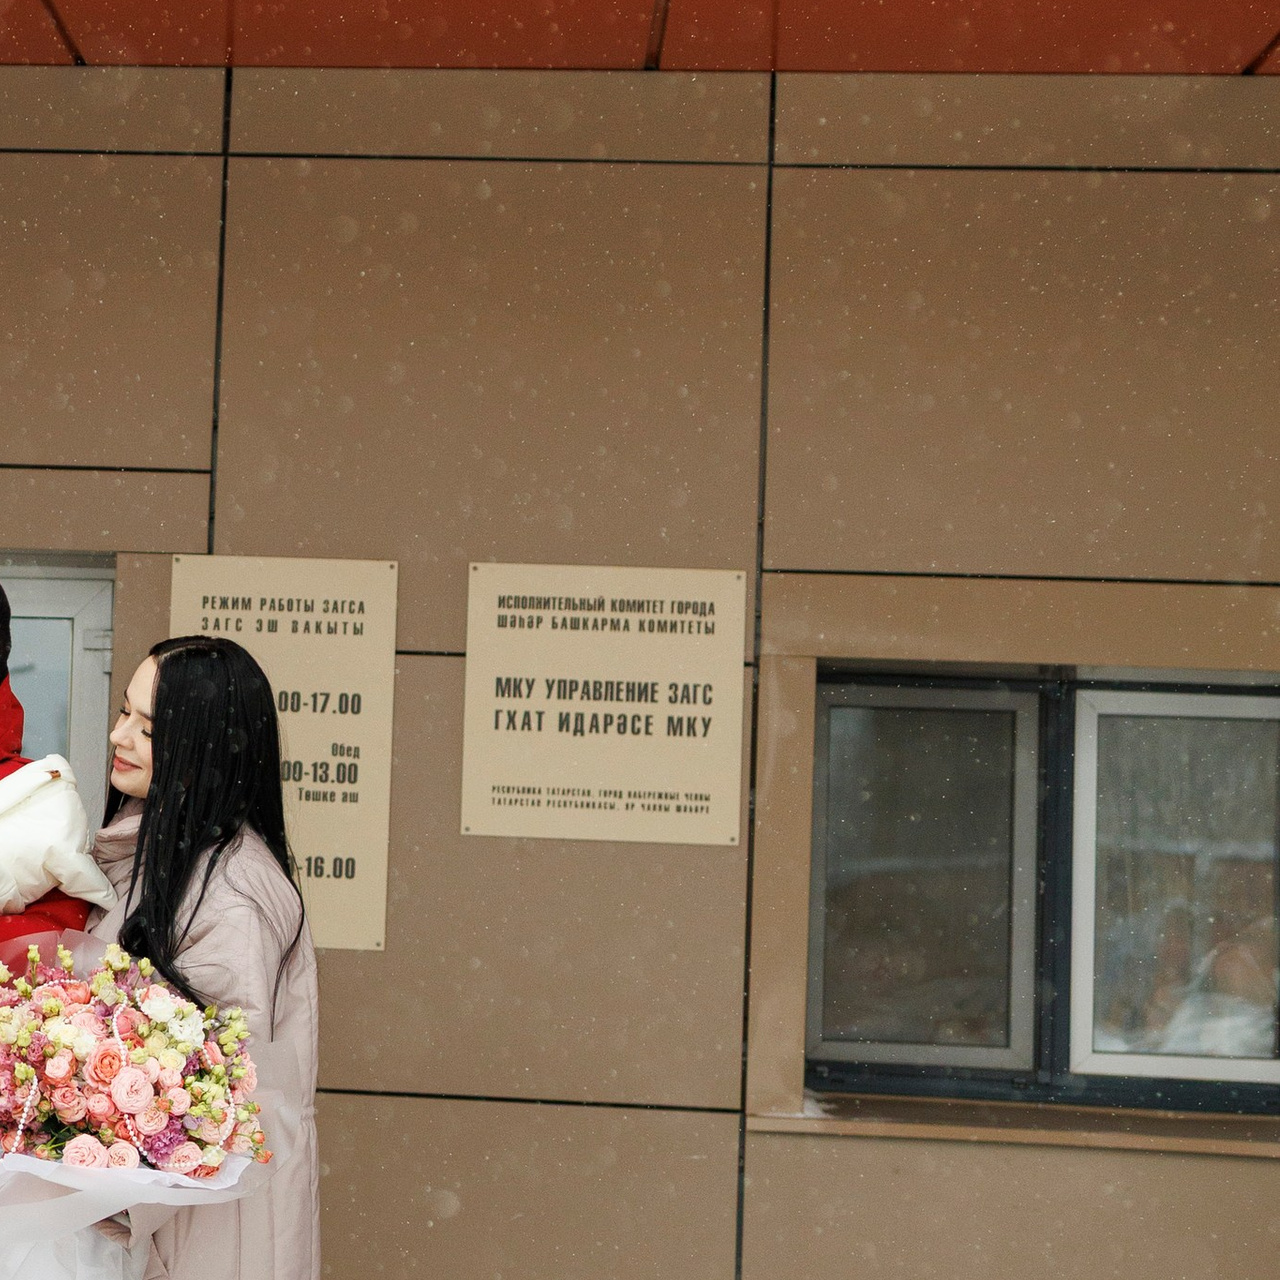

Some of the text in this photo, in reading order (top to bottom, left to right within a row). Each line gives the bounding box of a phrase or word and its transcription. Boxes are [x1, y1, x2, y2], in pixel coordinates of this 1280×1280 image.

[202, 595, 365, 614] РЕЖИМ РАБОТЫ ЗАГСА
[497, 594, 715, 617] ИСПОЛНИТЕЛЬНЫЙ КОМИТЕТ ГОРОДА
[201, 617, 364, 636] ЗАГС ЭШ ВАКЫТЫ
[551, 616, 630, 632] БАШКАРМА
[638, 618, 715, 635] КОМИТЕТЫ
[494, 676, 713, 705] МКУ УПРАВЛЕНИЕ ЗАГС
[278, 690, 362, 715] 00-17.00
[493, 709, 712, 738] ГХАТ ИДАРӘСЕ МКУ
[331, 742, 360, 759] Обед
[280, 760, 359, 784] 00-13.00
[341, 791, 359, 803] аш
[289, 855, 356, 879] -16.00
